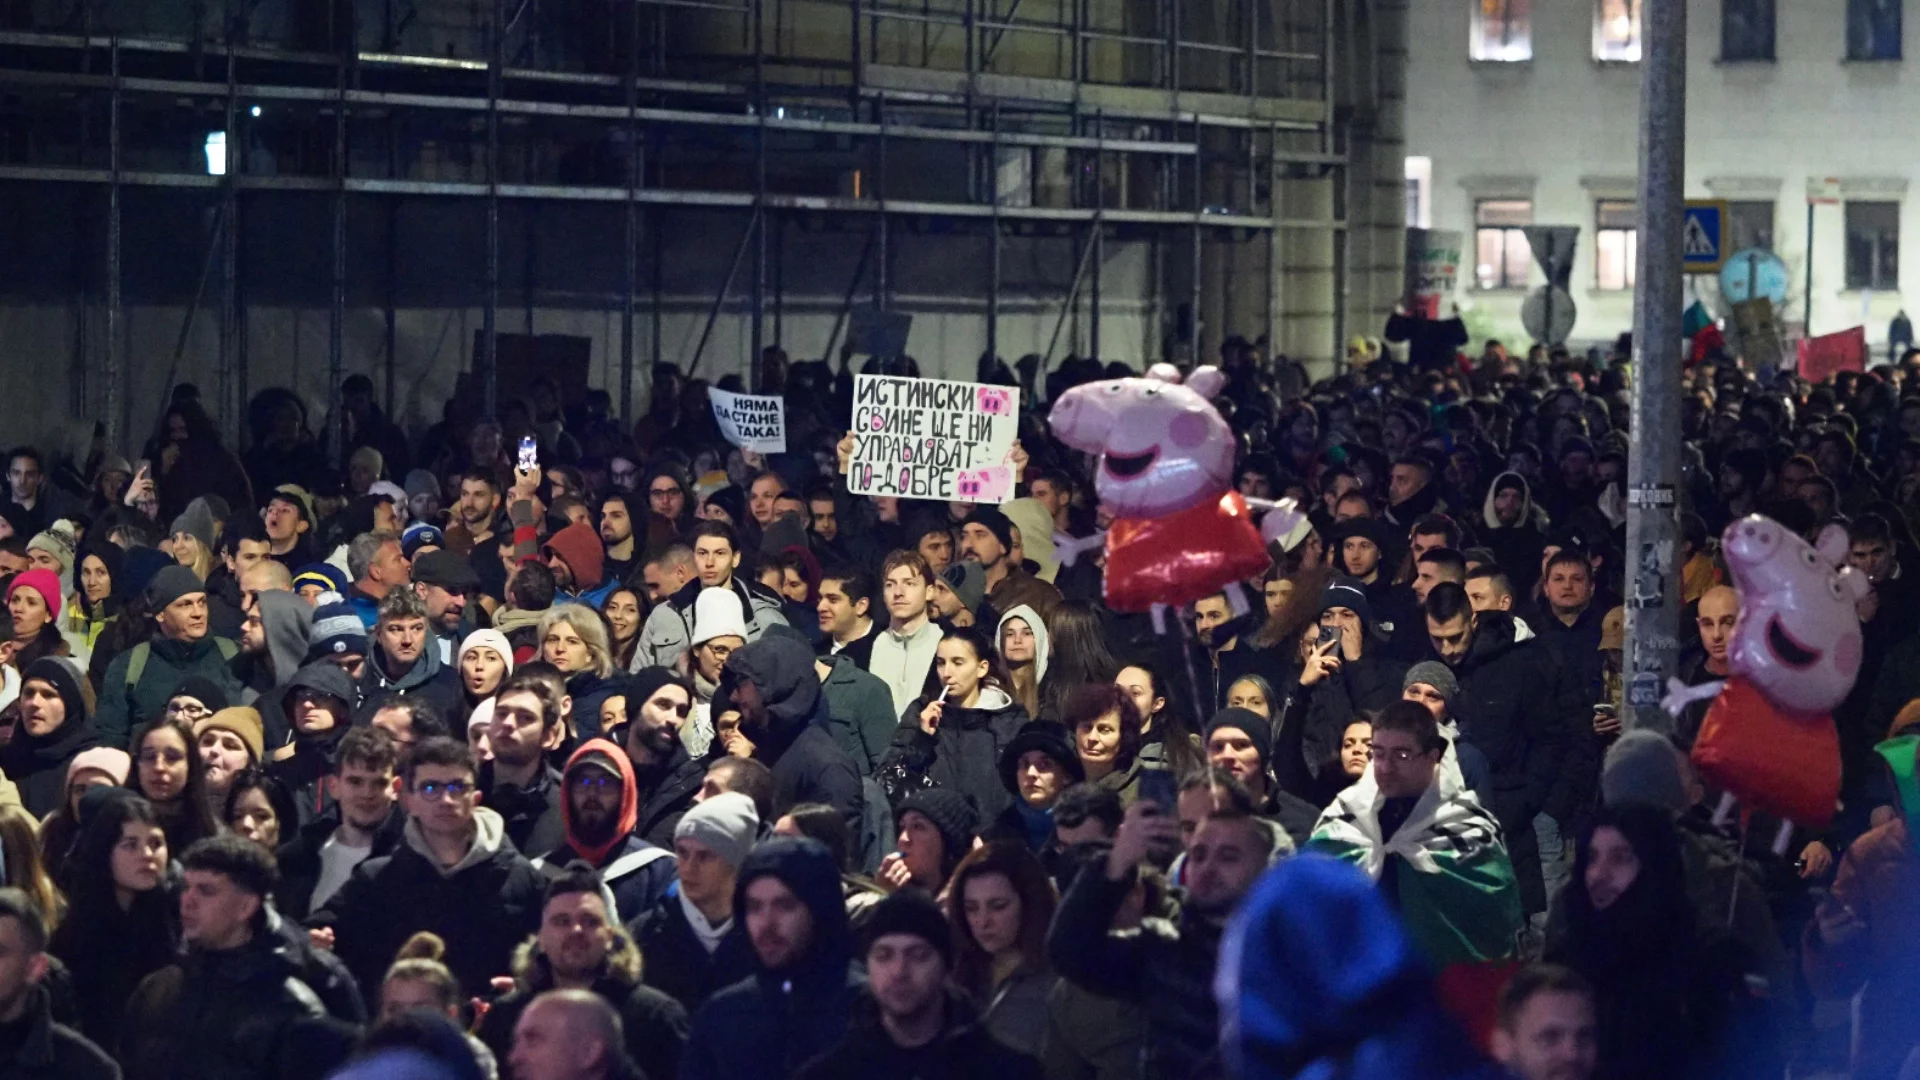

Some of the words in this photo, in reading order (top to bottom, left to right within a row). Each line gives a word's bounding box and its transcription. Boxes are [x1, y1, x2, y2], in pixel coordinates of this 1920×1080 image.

[734, 397, 779, 411] НЯМА
[858, 378, 974, 411] ИСТИНСКИ
[732, 410, 779, 425] СТАНЕ
[736, 424, 780, 438] ТАКА!
[856, 406, 923, 436] СВИНЕ
[931, 410, 963, 440] ЩЕ
[968, 414, 993, 442] НИ
[854, 434, 978, 469] УПРАВЛЯВАТ
[851, 461, 955, 497] ПО-ДОБРЕ
